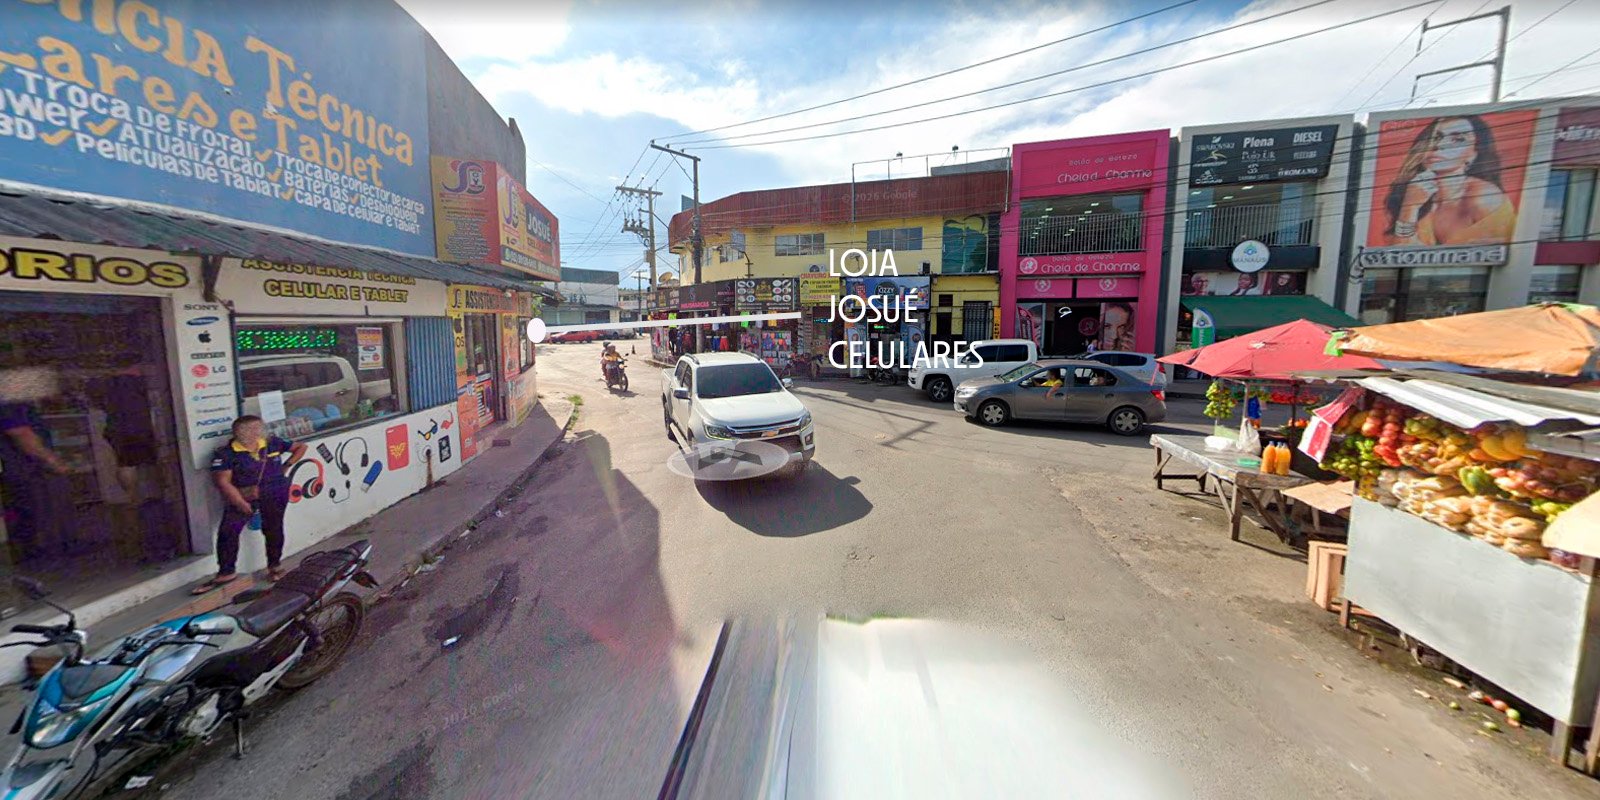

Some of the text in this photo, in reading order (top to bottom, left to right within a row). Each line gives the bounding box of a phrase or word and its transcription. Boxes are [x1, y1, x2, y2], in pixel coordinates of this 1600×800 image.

[1243, 137, 1275, 148] Plena
[1293, 131, 1323, 143] DIESEL
[229, 109, 258, 141] e
[263, 105, 383, 189] Tablet
[1041, 261, 1141, 273] Cheia de Charme
[264, 279, 409, 303] CELULAR E TABLET
[184, 303, 219, 311] SONY
[212, 365, 227, 374] LG
[196, 416, 233, 427] NOKIA
